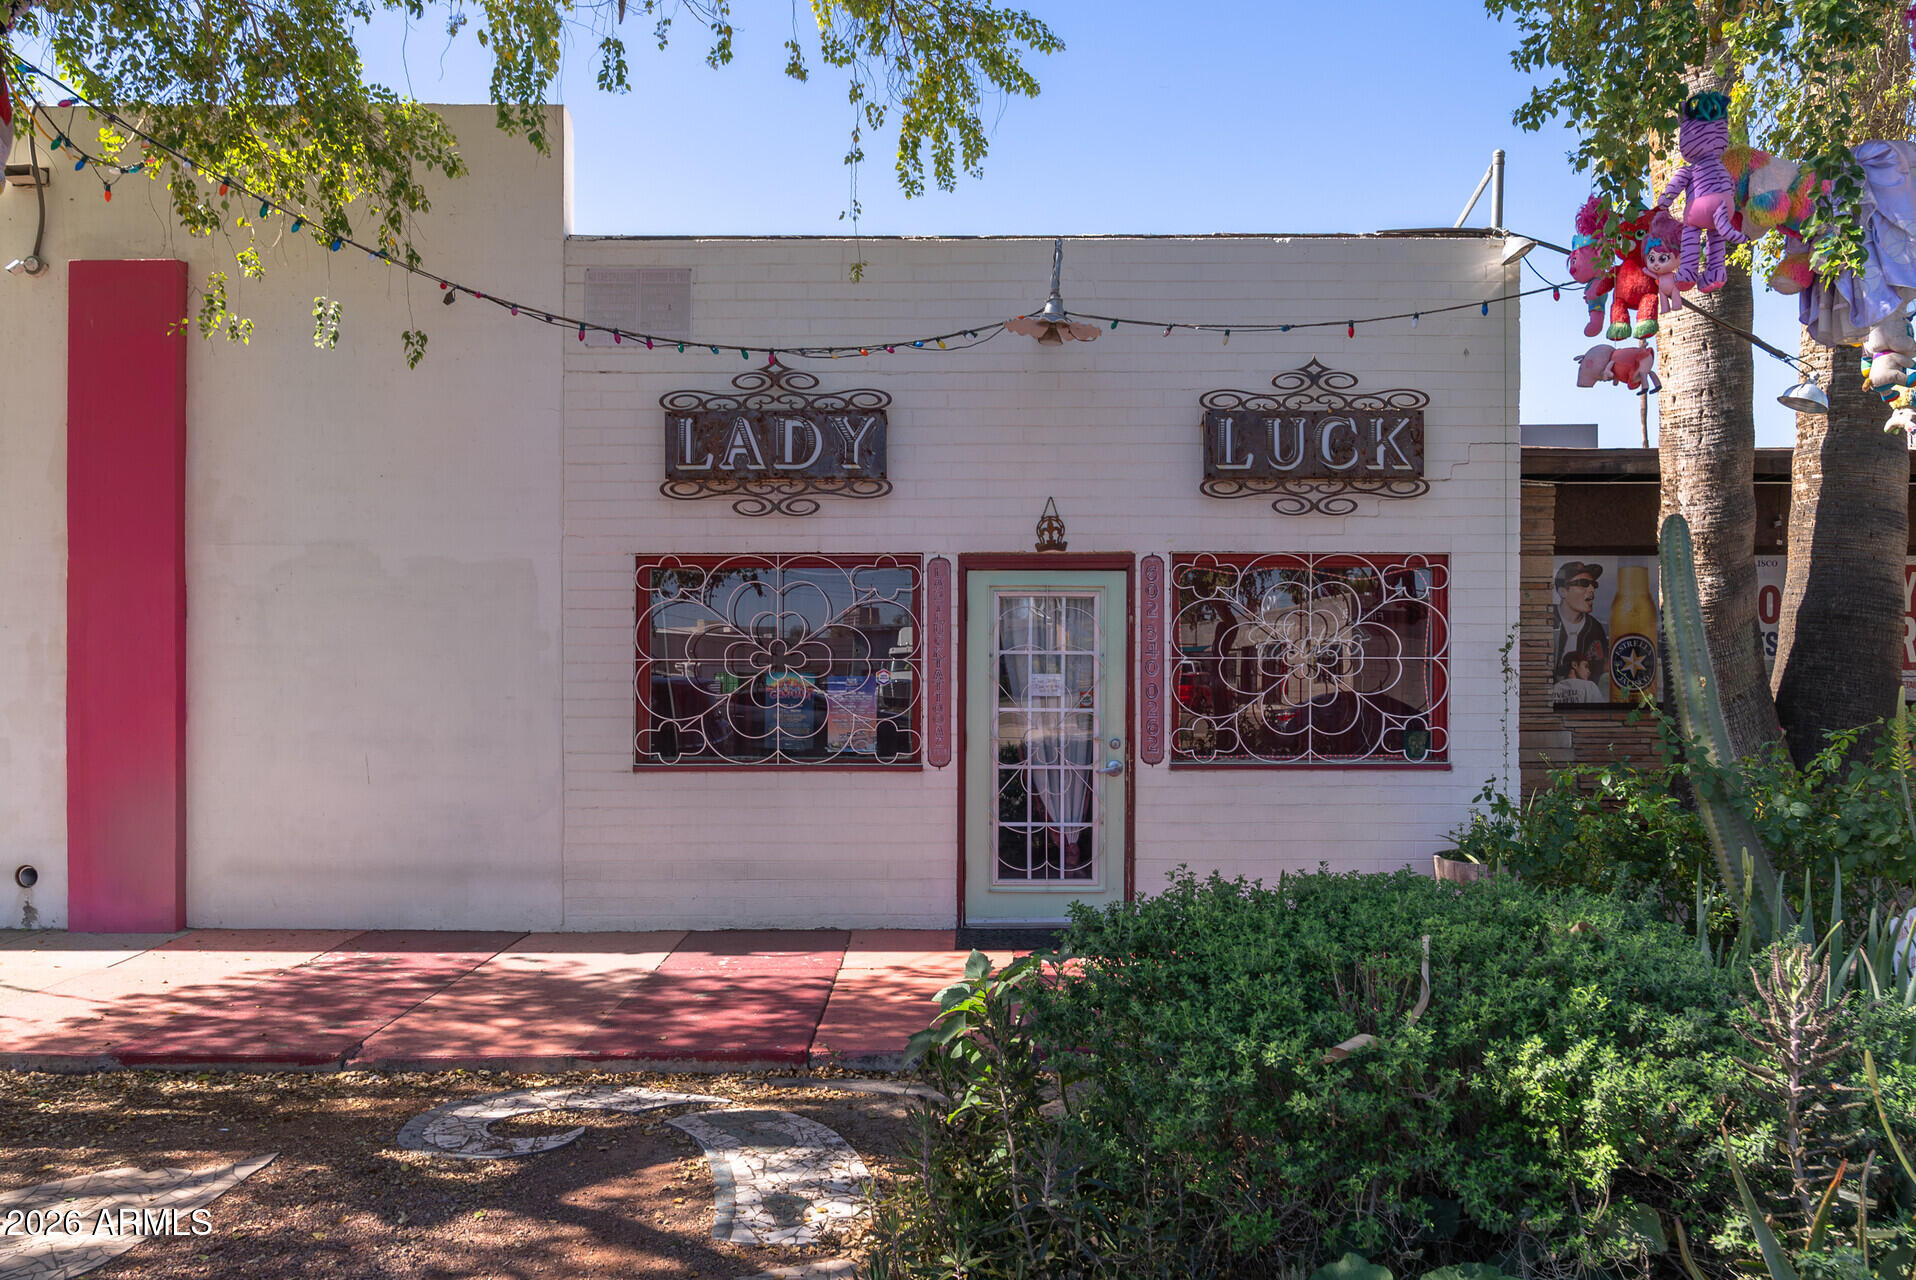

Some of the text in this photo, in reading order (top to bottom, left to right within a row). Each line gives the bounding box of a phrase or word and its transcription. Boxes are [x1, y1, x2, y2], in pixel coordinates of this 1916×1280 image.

[675, 415, 876, 471] LADY
[1215, 416, 1413, 471] LUCK
[1145, 565, 1160, 618] 602
[1144, 625, 1160, 677] 340
